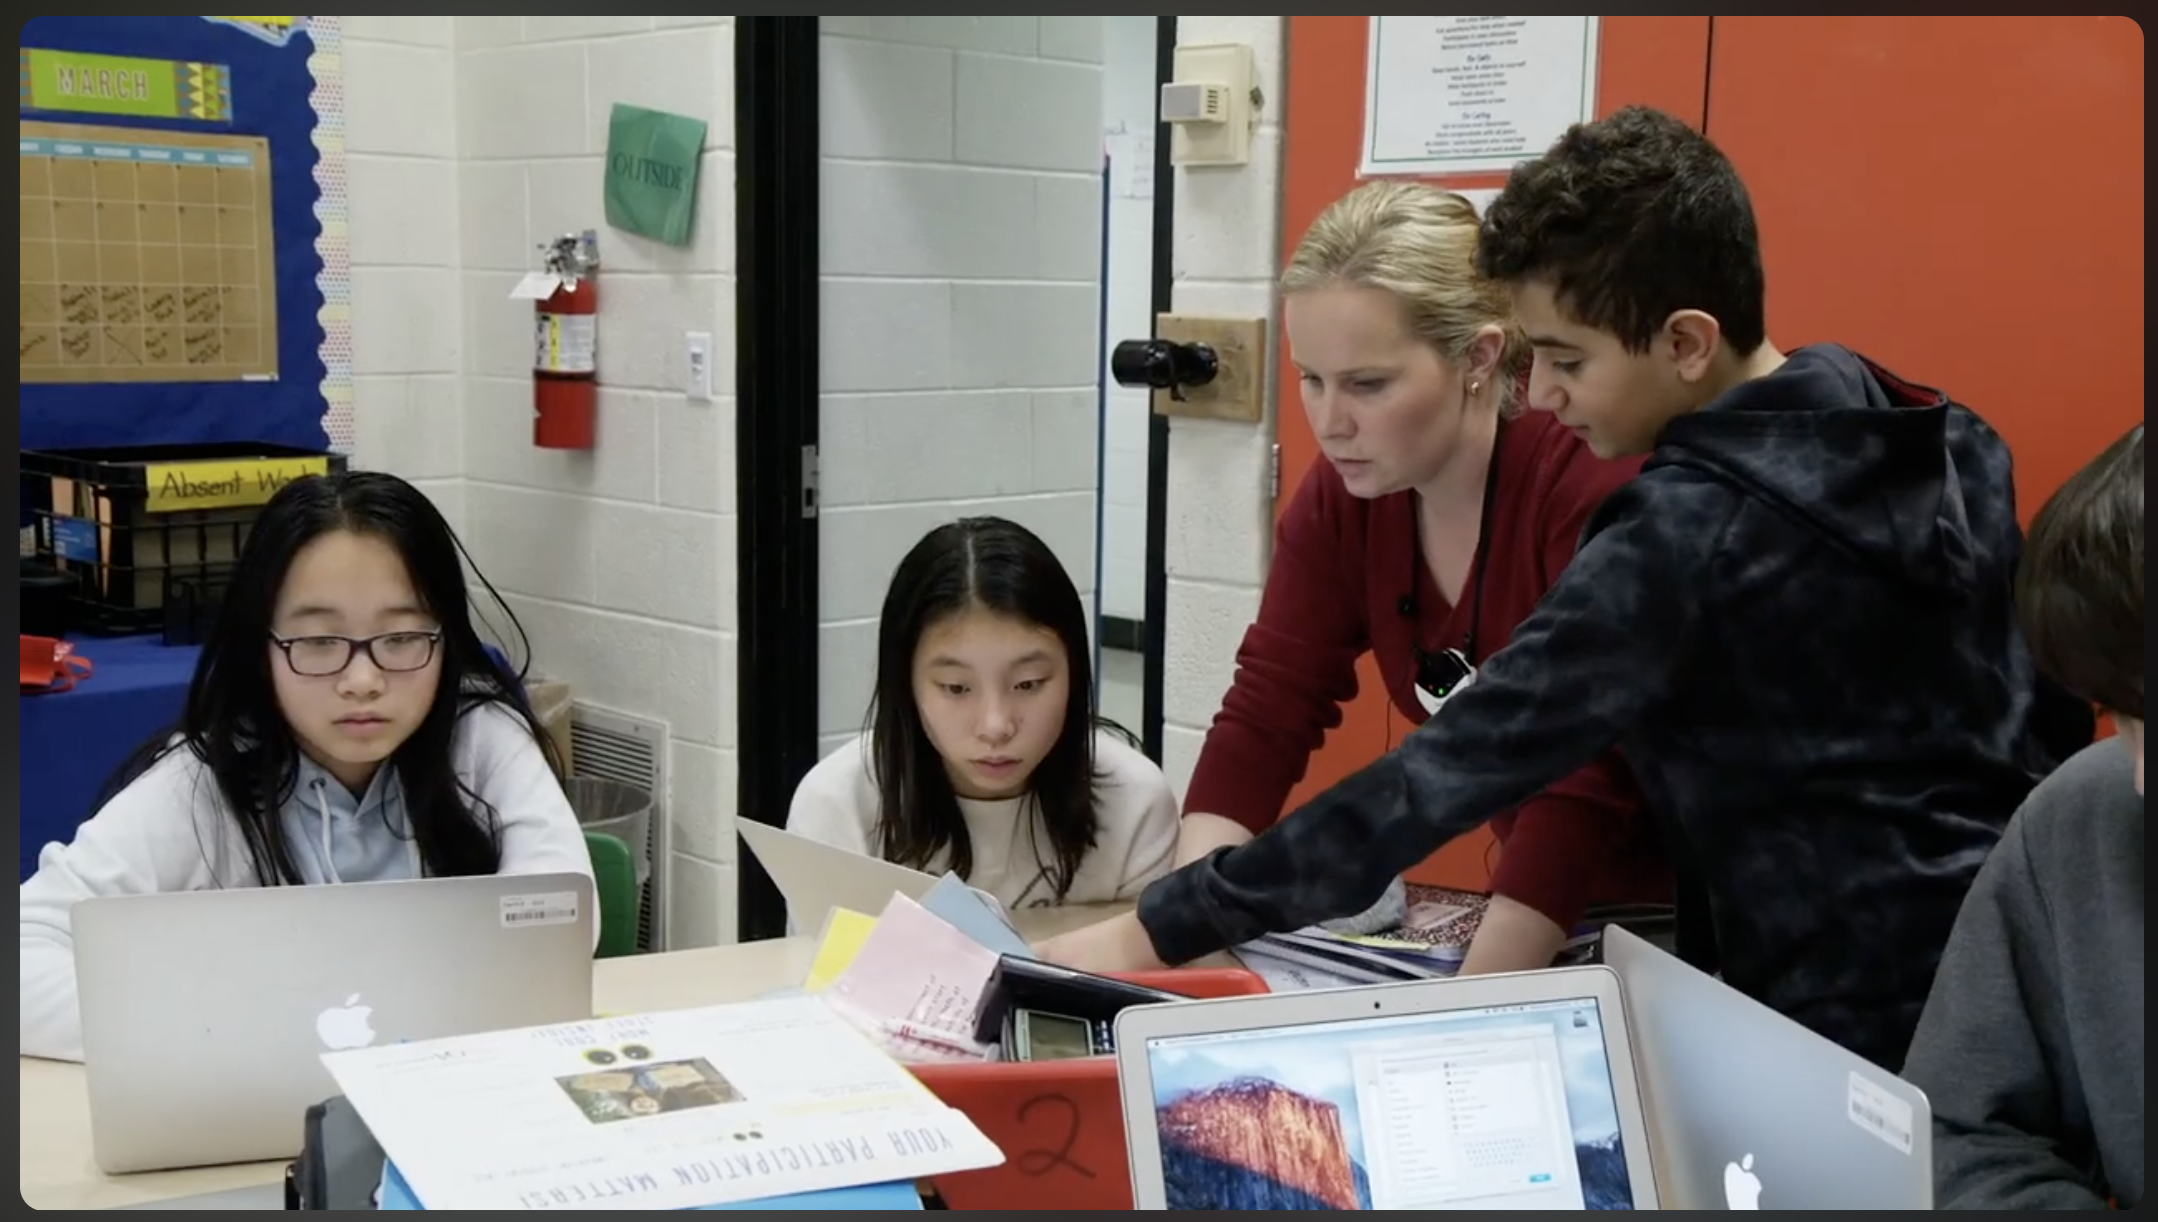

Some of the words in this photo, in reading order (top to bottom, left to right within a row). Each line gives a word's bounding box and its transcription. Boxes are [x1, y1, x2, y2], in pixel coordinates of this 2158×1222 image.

[57, 65, 150, 102] MARCH
[612, 152, 684, 192] OUTSIDE
[159, 470, 244, 498] Absent
[887, 1126, 953, 1155] YOUR
[1017, 1092, 1097, 1179] 2
[673, 1135, 875, 1186] PARTICIPATION
[519, 1174, 656, 1209] MATTERS!
